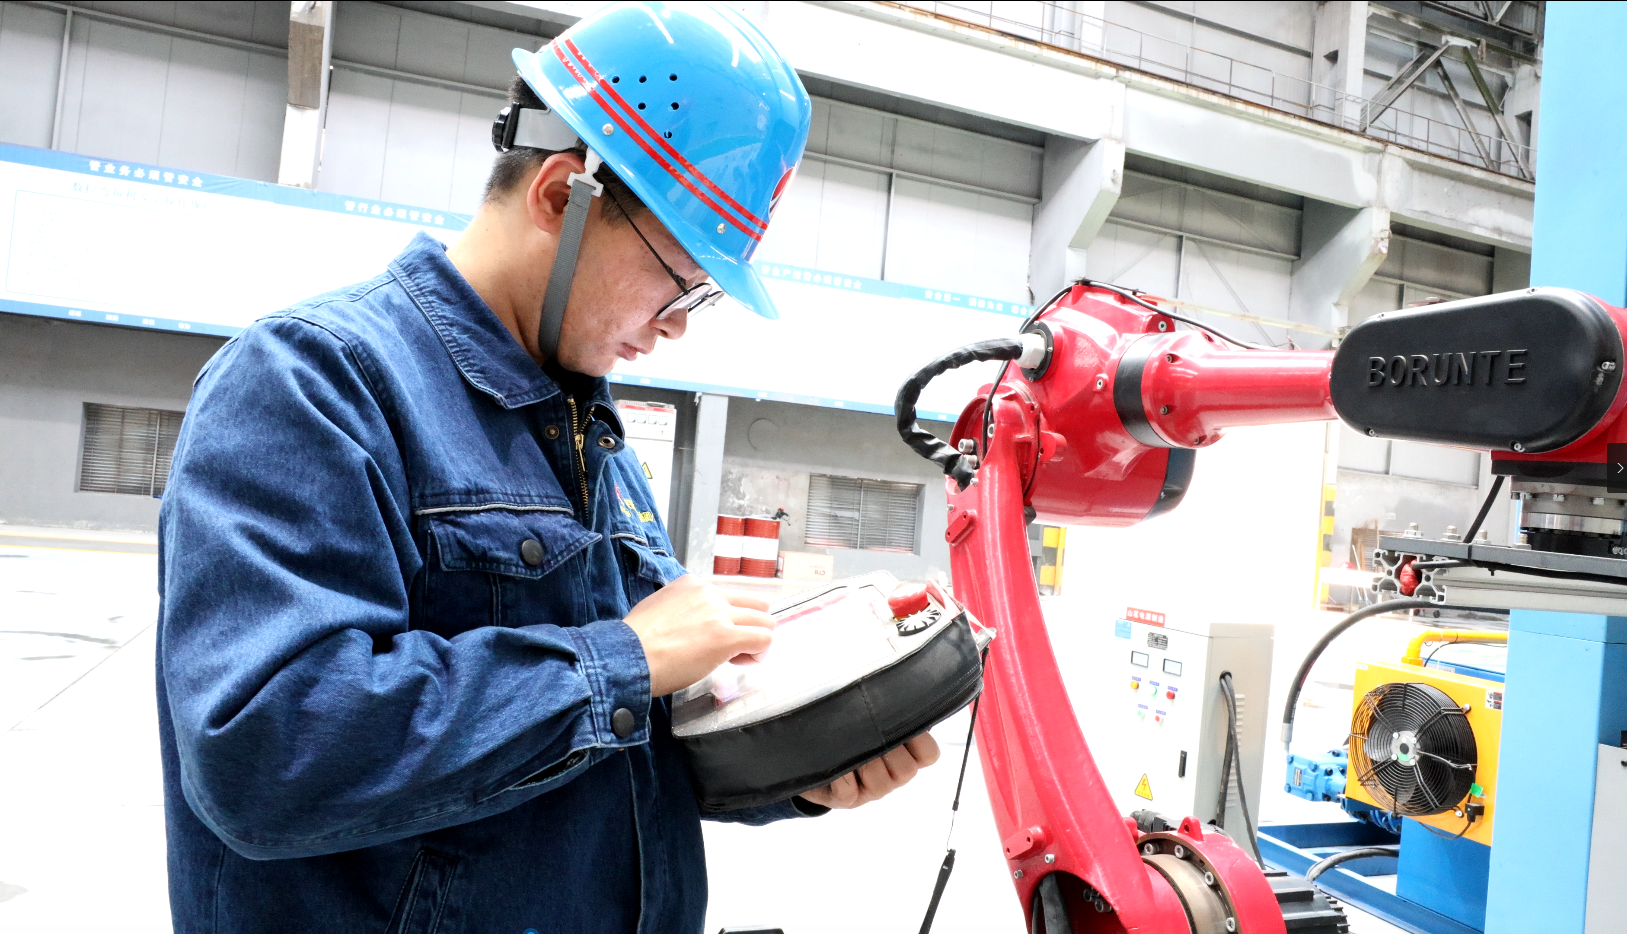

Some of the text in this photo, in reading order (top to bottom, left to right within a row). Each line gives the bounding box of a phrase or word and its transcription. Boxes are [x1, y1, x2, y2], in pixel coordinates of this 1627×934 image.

[89, 160, 203, 187] 管业务必须管安全
[345, 200, 444, 225] 管行业必须管安全
[1367, 349, 1528, 388] BORUNTE
